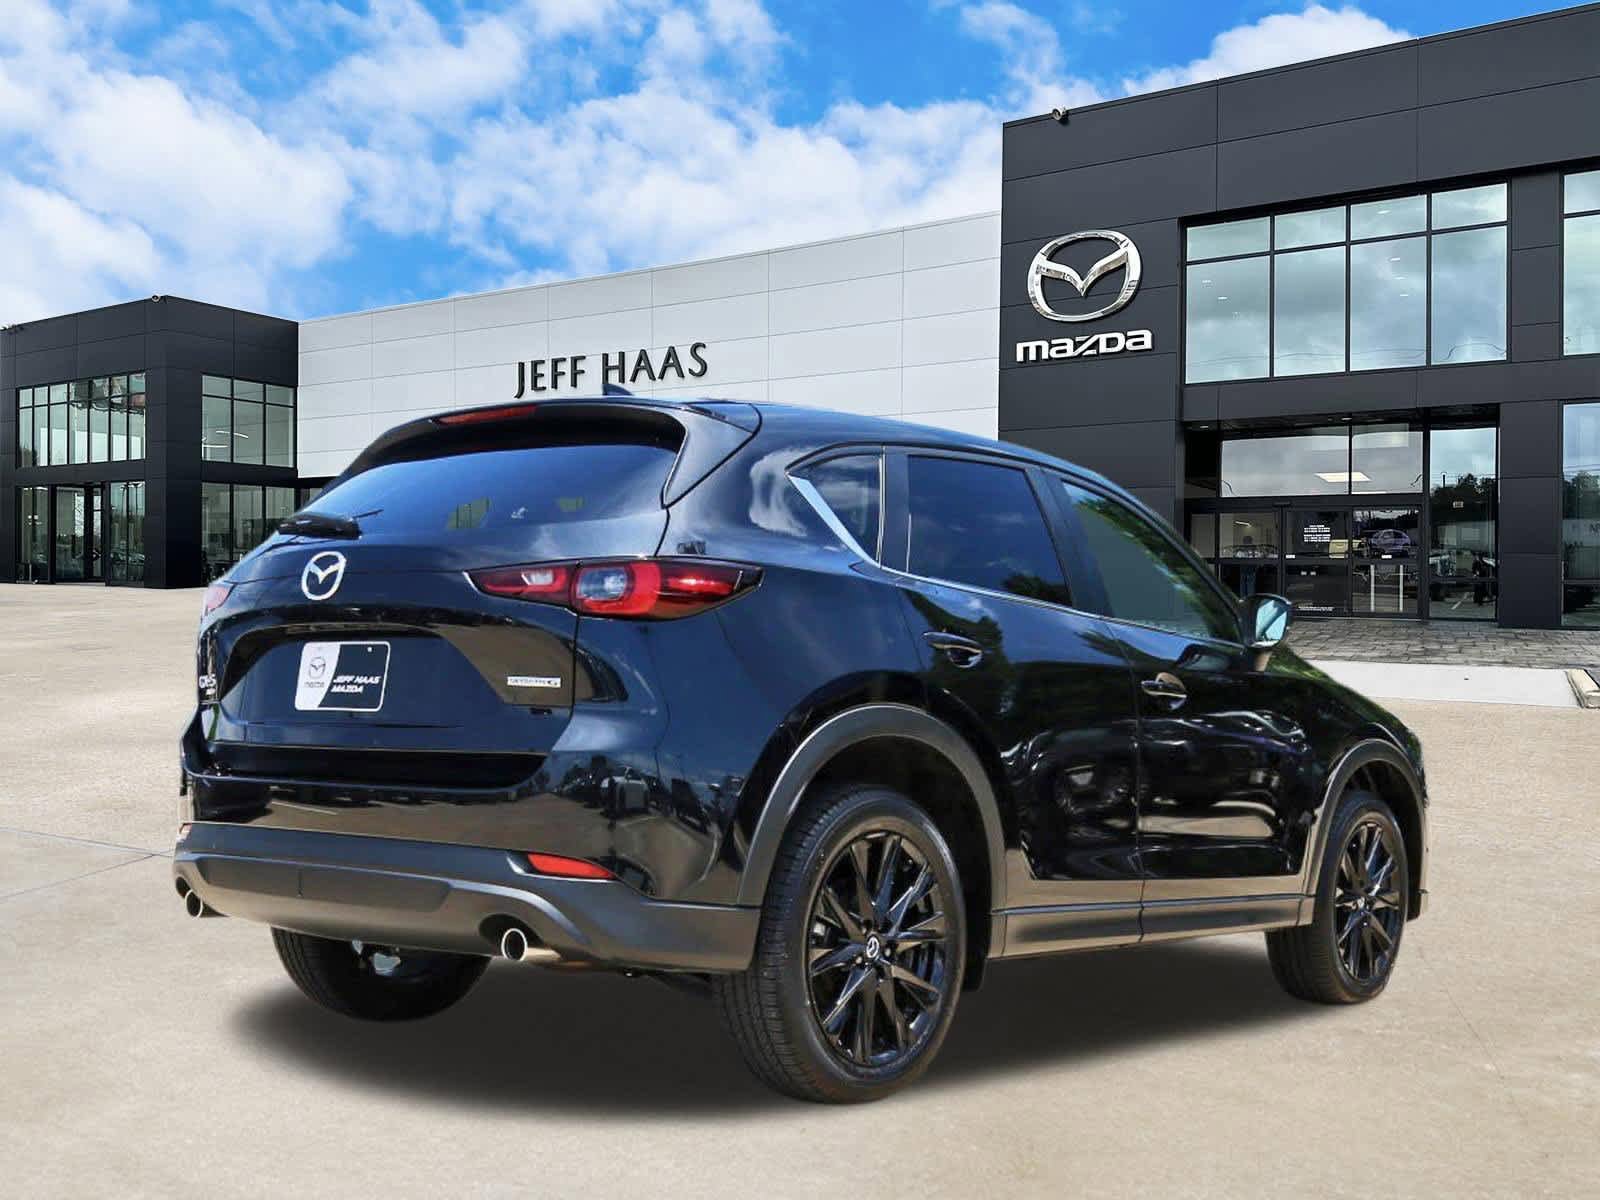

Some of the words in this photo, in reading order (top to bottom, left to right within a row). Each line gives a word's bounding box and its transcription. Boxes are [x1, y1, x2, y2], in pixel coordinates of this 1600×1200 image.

[513, 355, 587, 399] JEFF
[601, 342, 708, 385] HAAS
[333, 675, 355, 683] JEFF
[354, 675, 381, 684] HAAS
